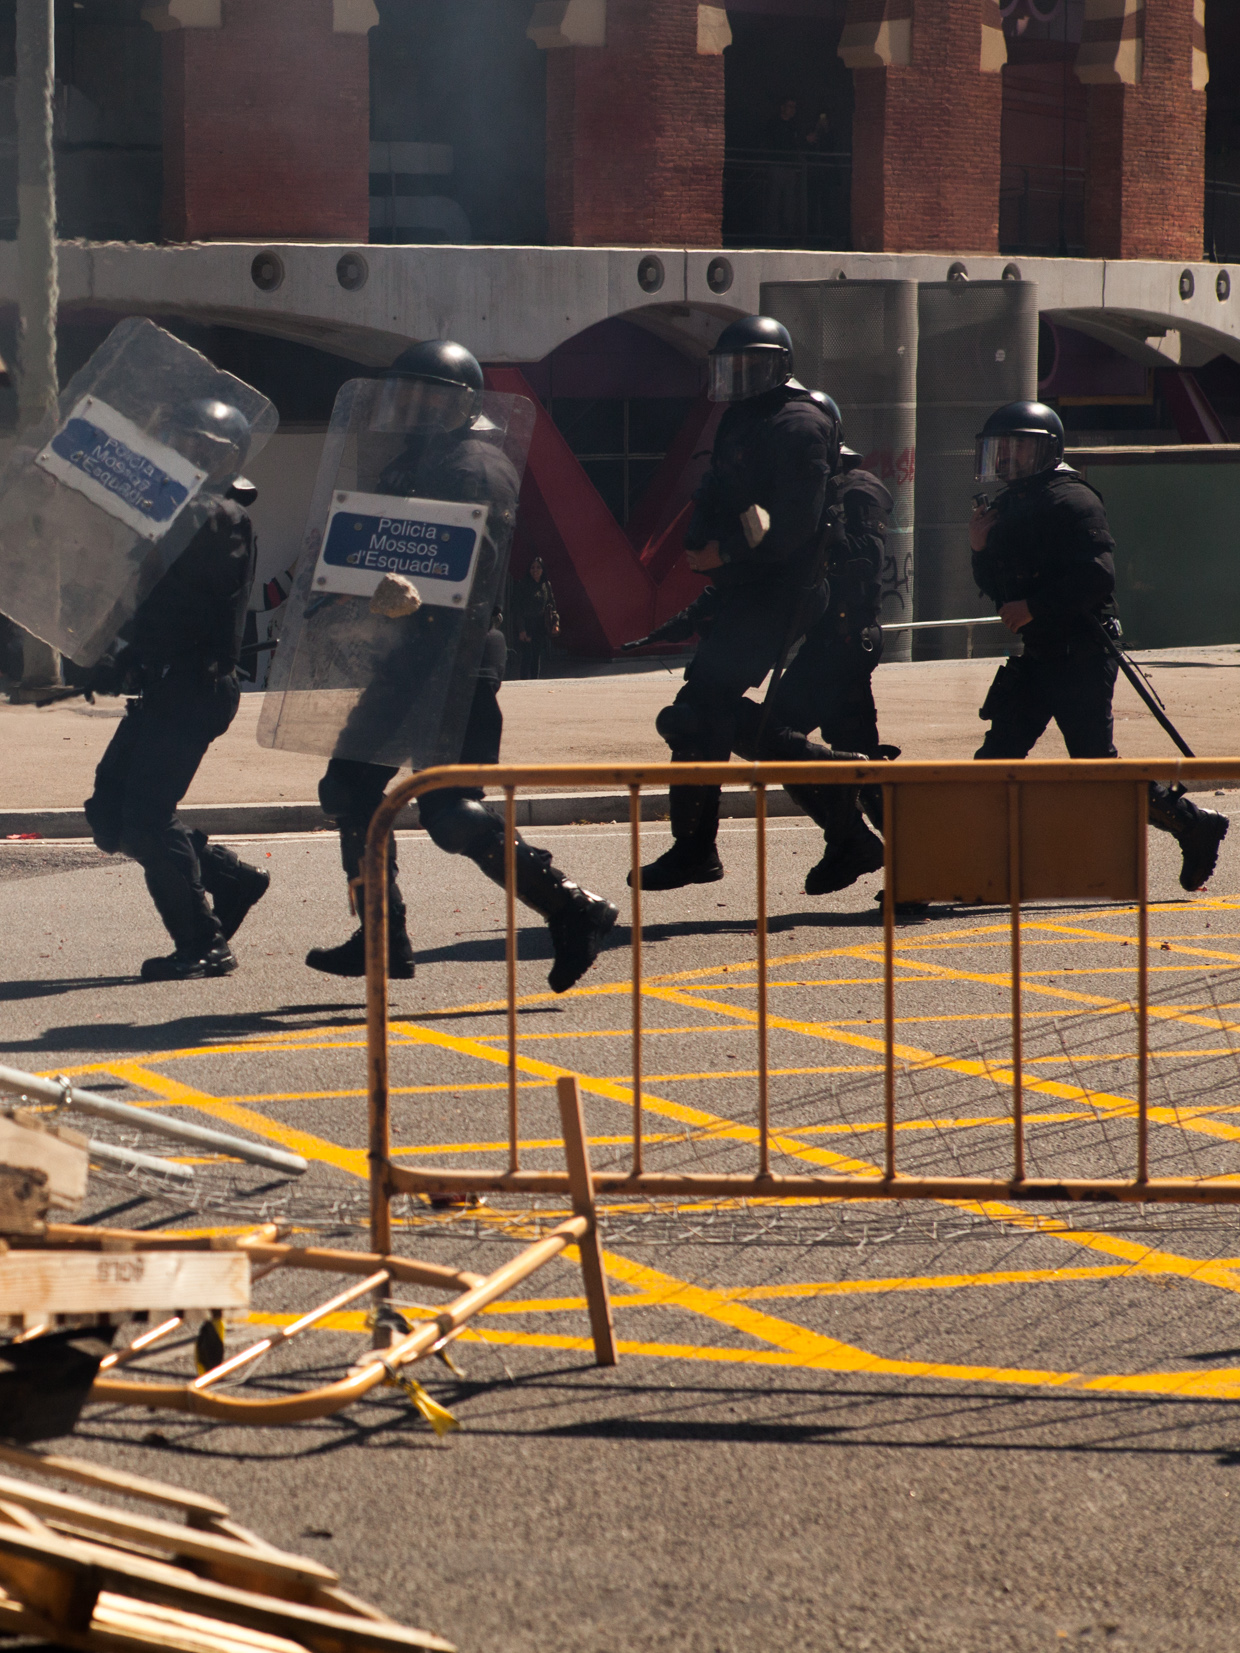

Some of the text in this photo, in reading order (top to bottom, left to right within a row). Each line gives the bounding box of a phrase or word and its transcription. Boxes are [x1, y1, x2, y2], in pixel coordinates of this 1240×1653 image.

[377, 518, 437, 540] Policia
[369, 534, 438, 557] Mossos
[350, 549, 450, 576] d'Esquadra
